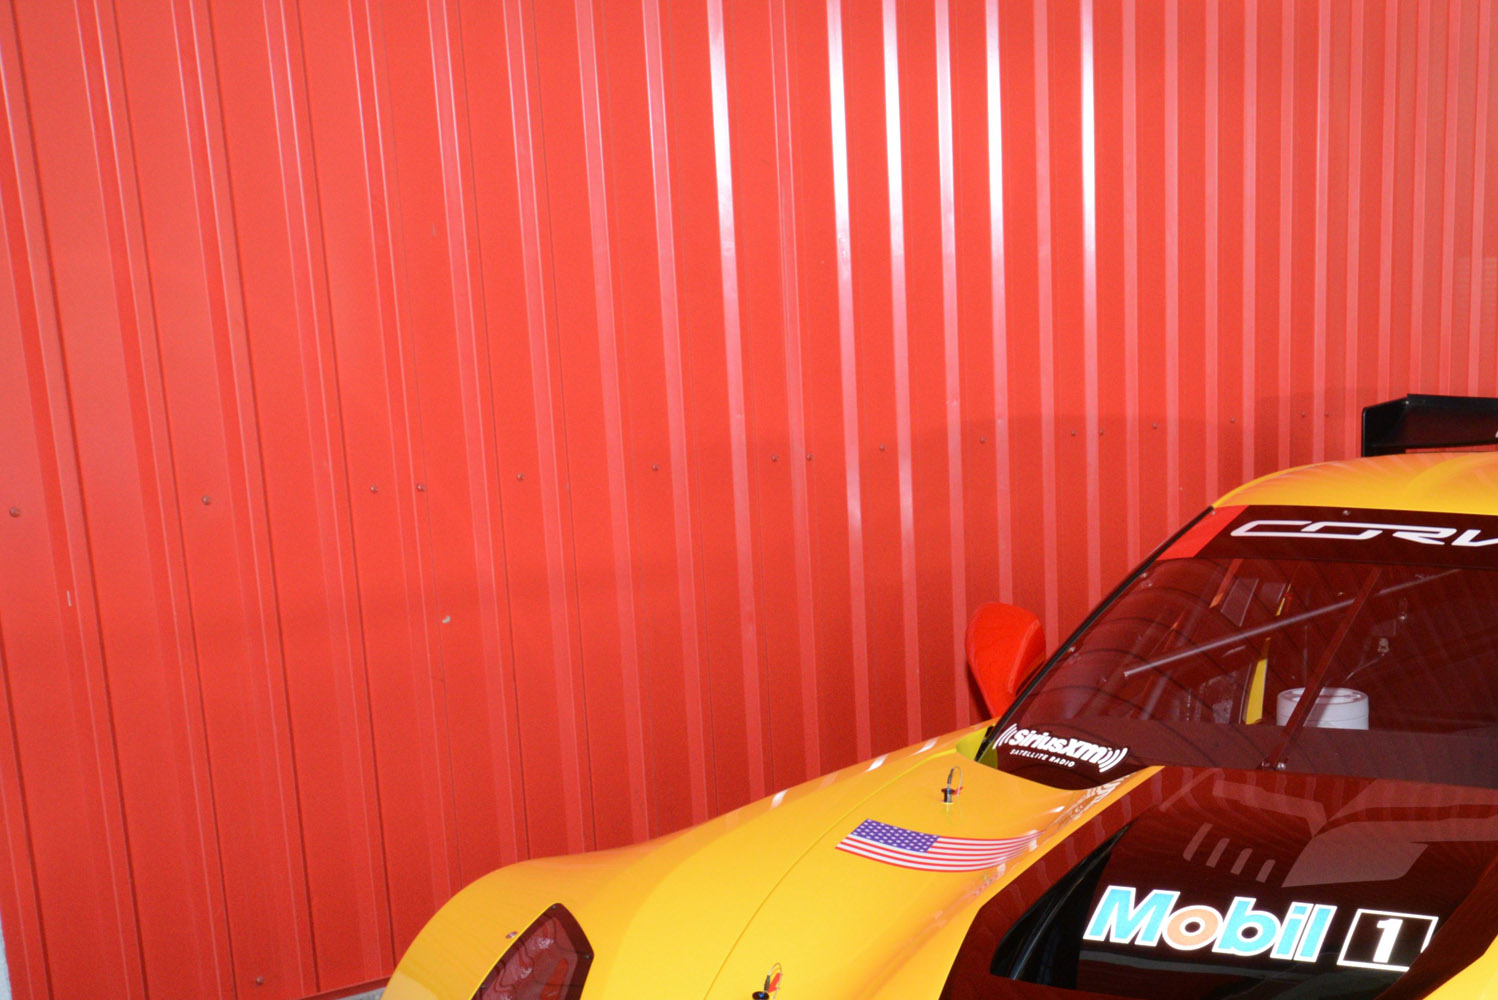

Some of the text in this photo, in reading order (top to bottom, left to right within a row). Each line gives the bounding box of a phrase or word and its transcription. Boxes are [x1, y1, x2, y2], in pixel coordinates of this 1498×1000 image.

[1010, 748, 1075, 768] SATELLITE RADIO
[1083, 885, 1404, 964] Mobil 1
